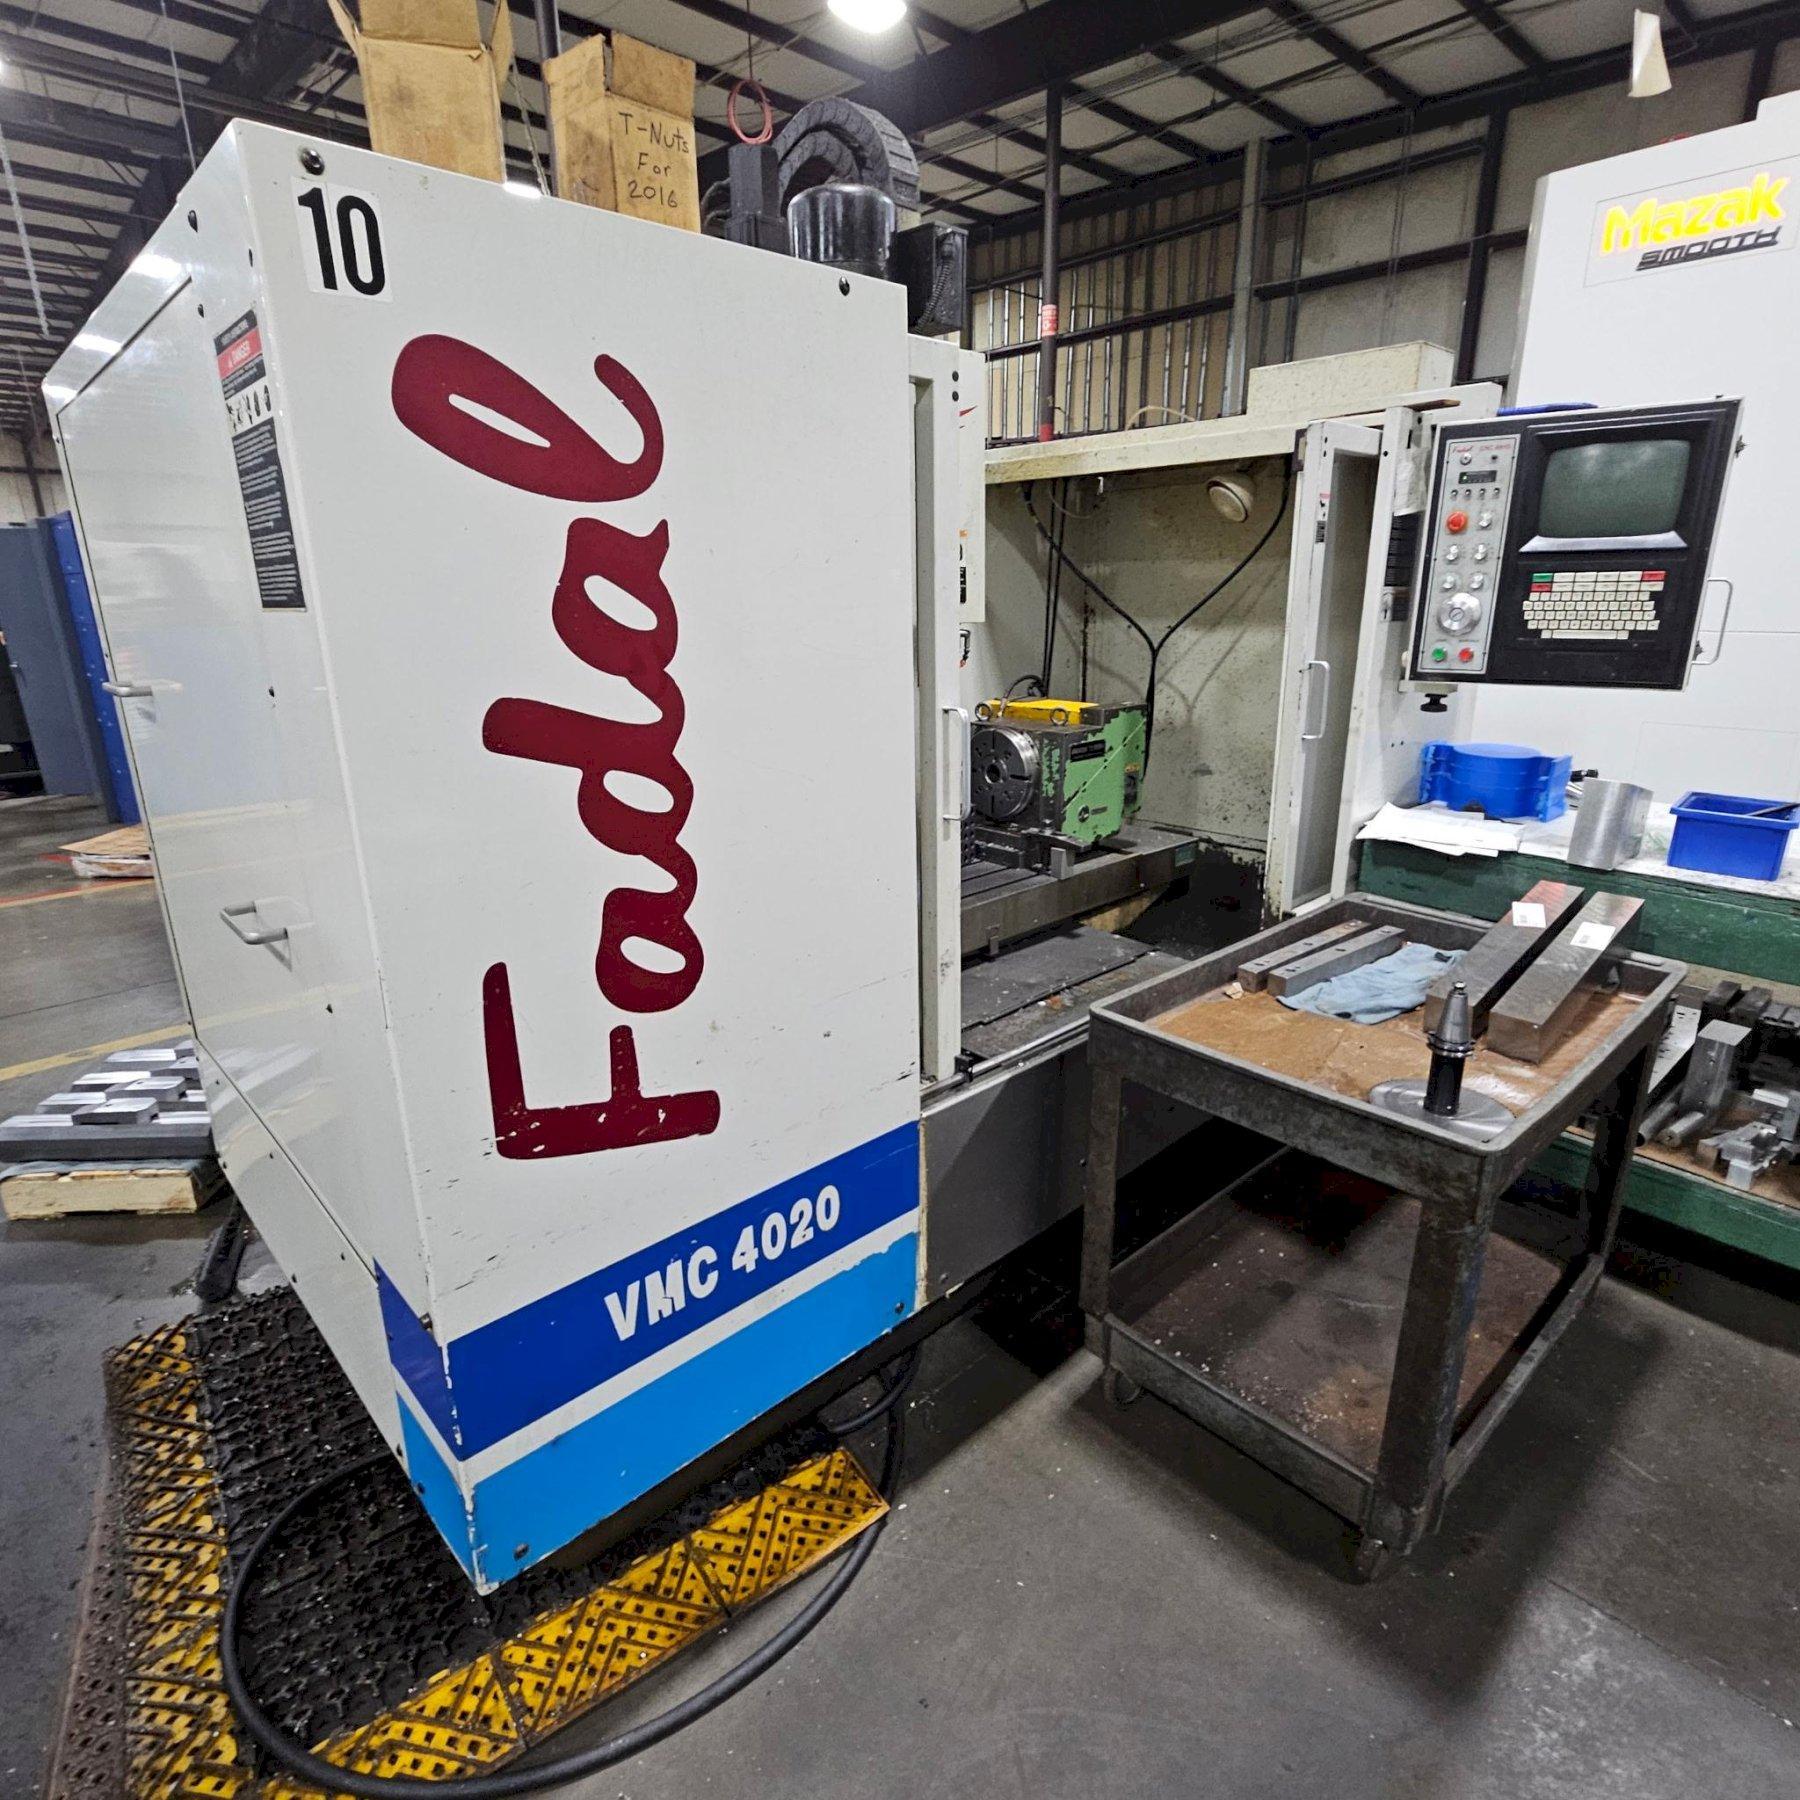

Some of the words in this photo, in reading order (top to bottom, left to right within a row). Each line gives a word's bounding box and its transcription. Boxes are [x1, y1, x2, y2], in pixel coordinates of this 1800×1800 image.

[617, 111, 690, 154] T-Nuts
[637, 152, 672, 176] For
[627, 180, 679, 208] 2016
[1602, 172, 1791, 255] Mazak
[297, 187, 386, 296] 10
[1635, 225, 1782, 272] SMOOTH
[392, 334, 721, 1160] Fadal
[603, 1245, 719, 1342] VMC
[731, 1184, 841, 1274] 4020
